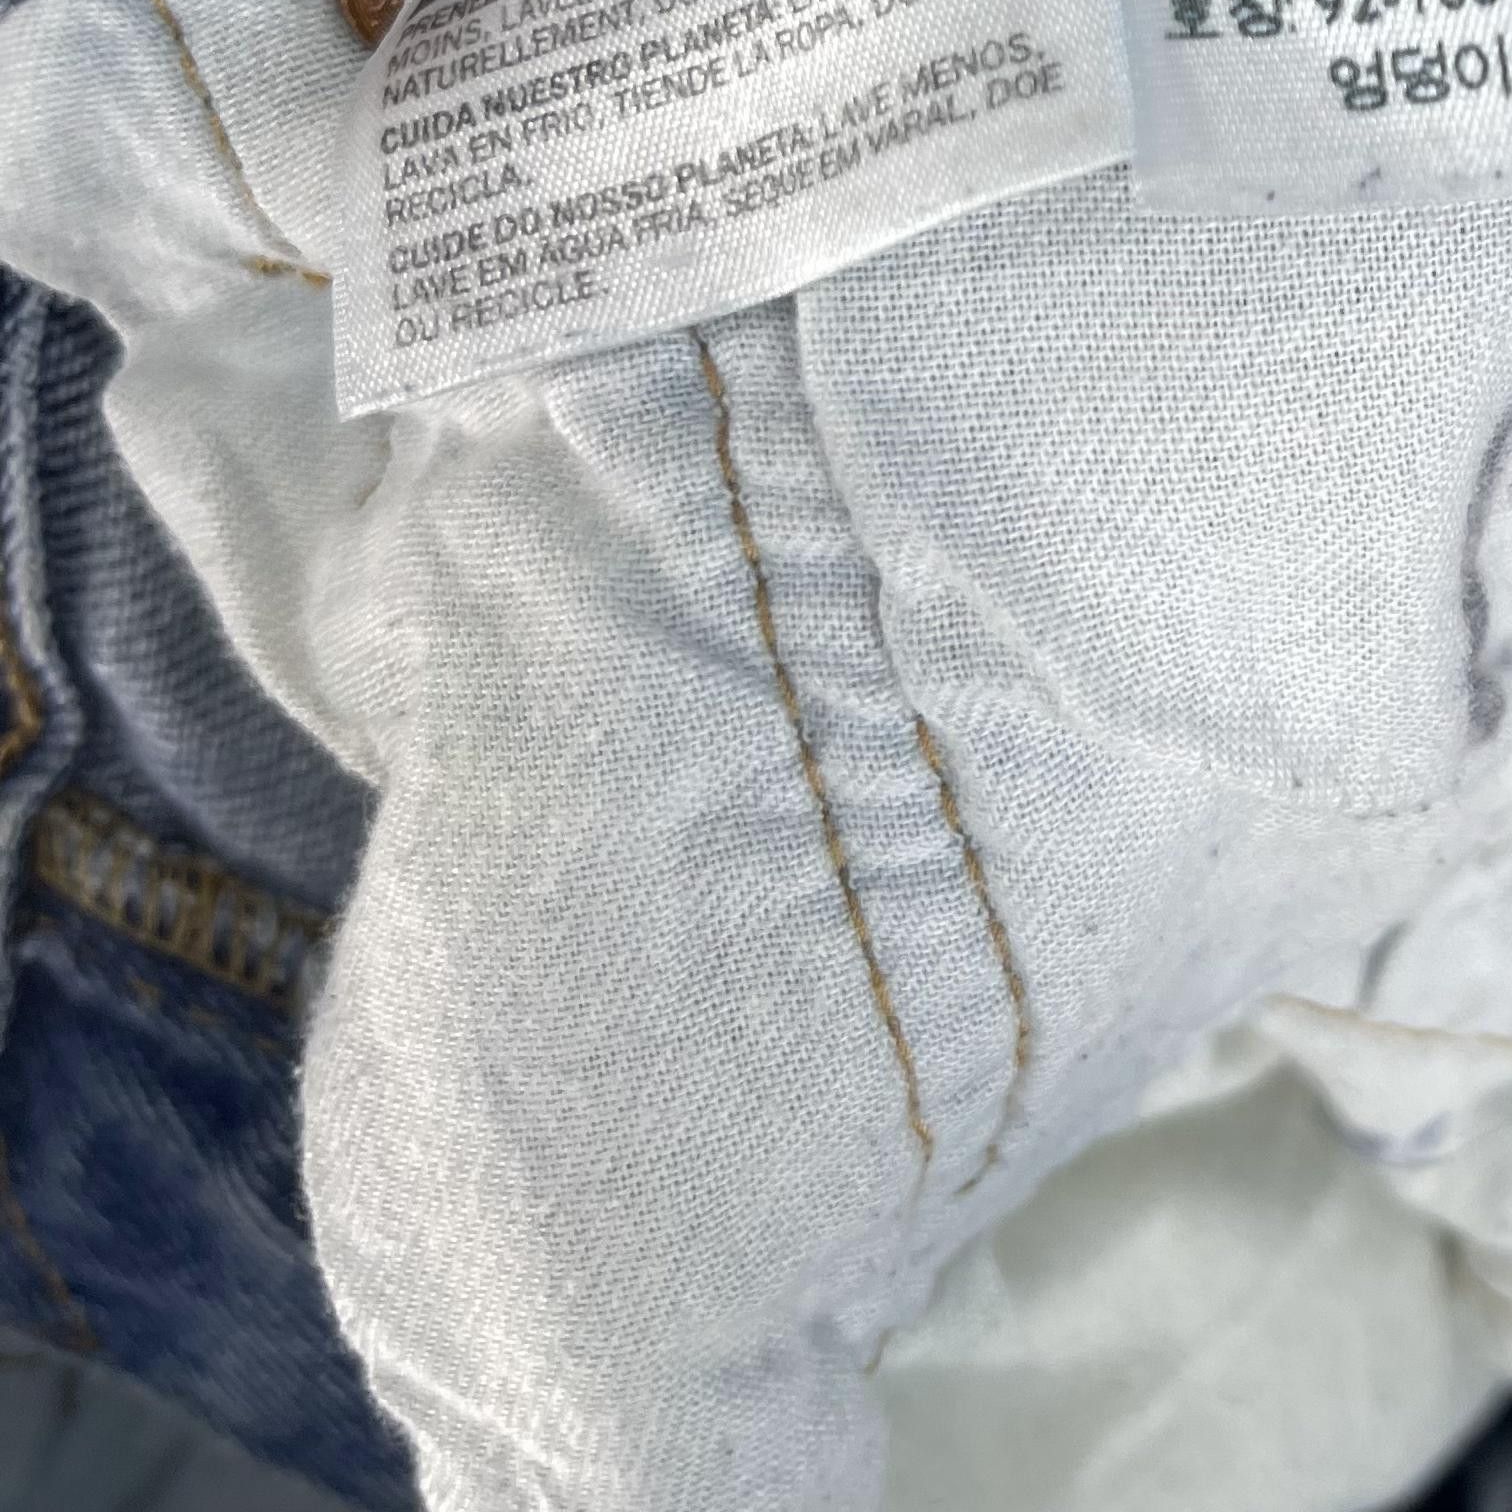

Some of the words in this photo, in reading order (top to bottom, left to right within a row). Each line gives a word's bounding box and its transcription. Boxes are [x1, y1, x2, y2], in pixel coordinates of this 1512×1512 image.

[380, 100, 477, 155] CUIDA
[481, 51, 633, 122] NUESTRO
[382, 143, 459, 191] LAVA
[469, 122, 513, 164] EN
[614, 56, 730, 115] TIENDE
[736, 39, 771, 78] LA
[389, 221, 489, 276] CUIDE
[493, 205, 542, 246] DO
[551, 173, 668, 230] NOSSO
[820, 81, 894, 141] LAVE
[392, 263, 472, 312] LAVE
[478, 246, 528, 288] EM
[819, 139, 862, 182] EM
[985, 61, 1065, 111] DOE
[395, 310, 439, 347] OU
